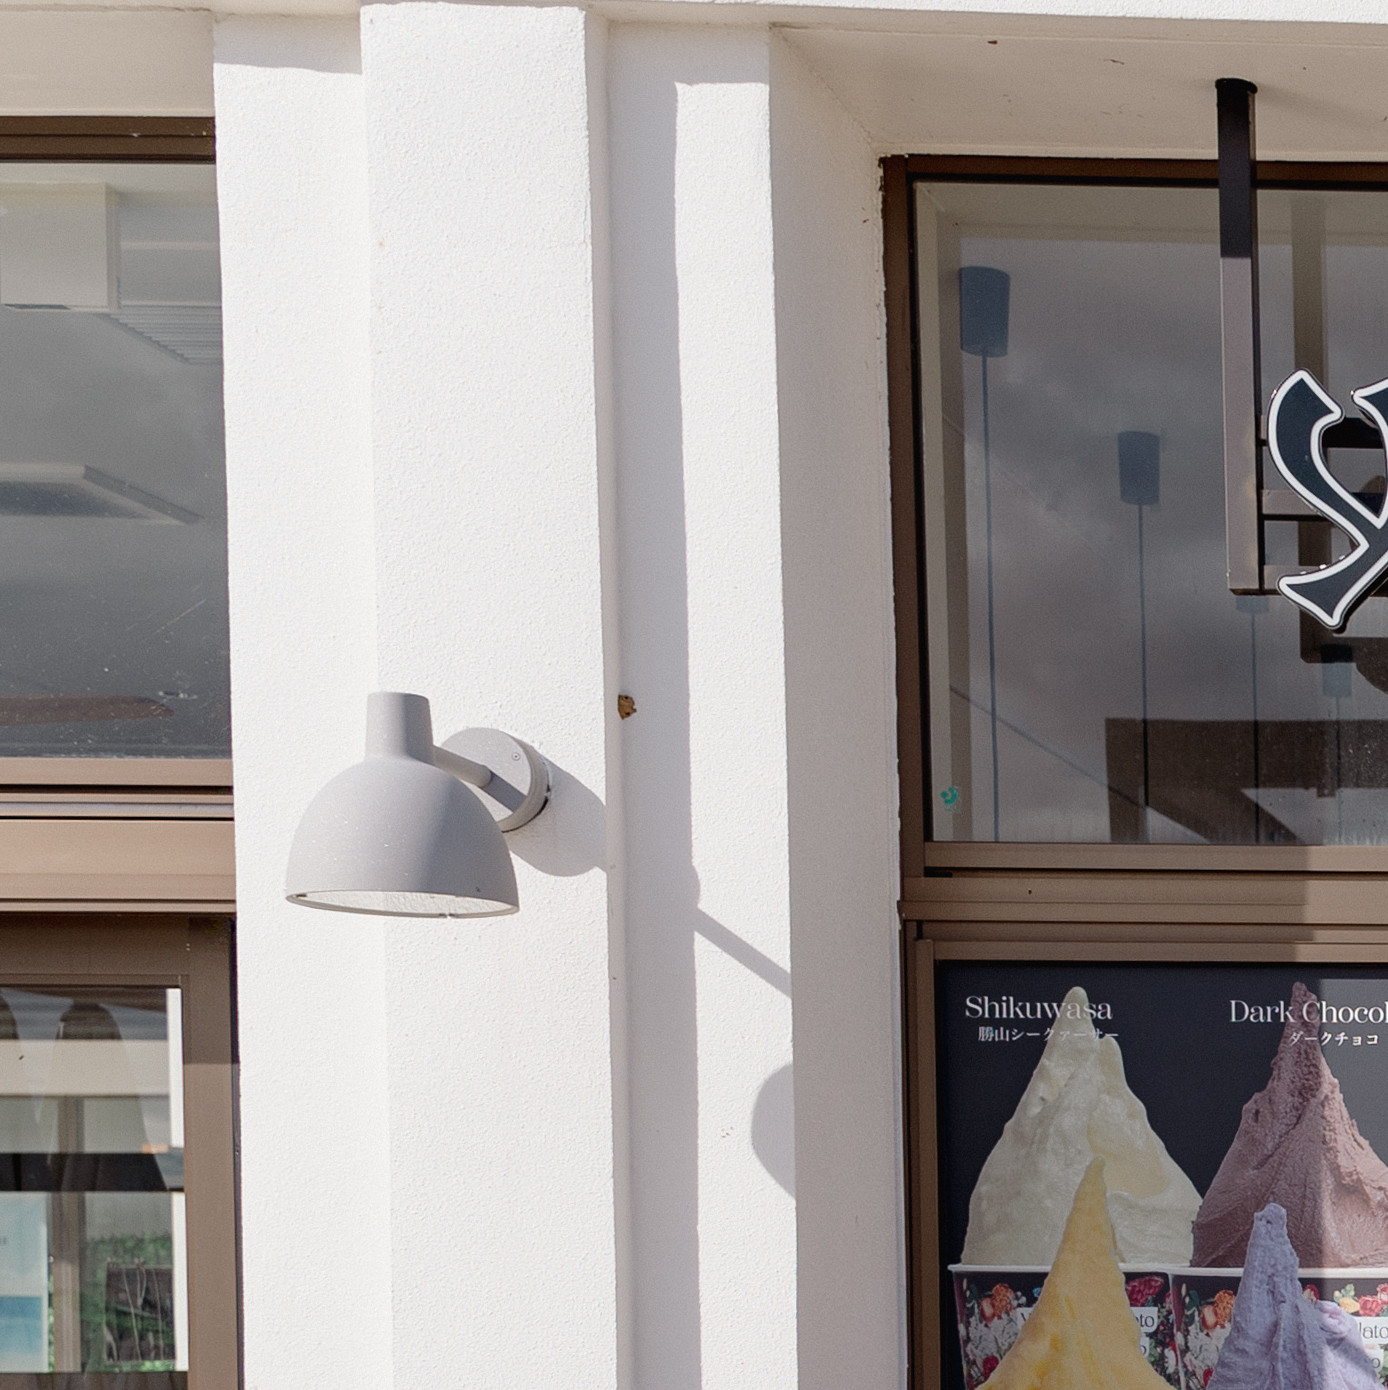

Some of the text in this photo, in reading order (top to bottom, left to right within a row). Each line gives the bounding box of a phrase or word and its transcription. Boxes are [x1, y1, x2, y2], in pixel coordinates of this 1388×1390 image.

[965, 995, 1113, 1019] Shikuwasa
[1229, 999, 1295, 1024] Dark
[1289, 1030, 1379, 1047] ダークチョコ
